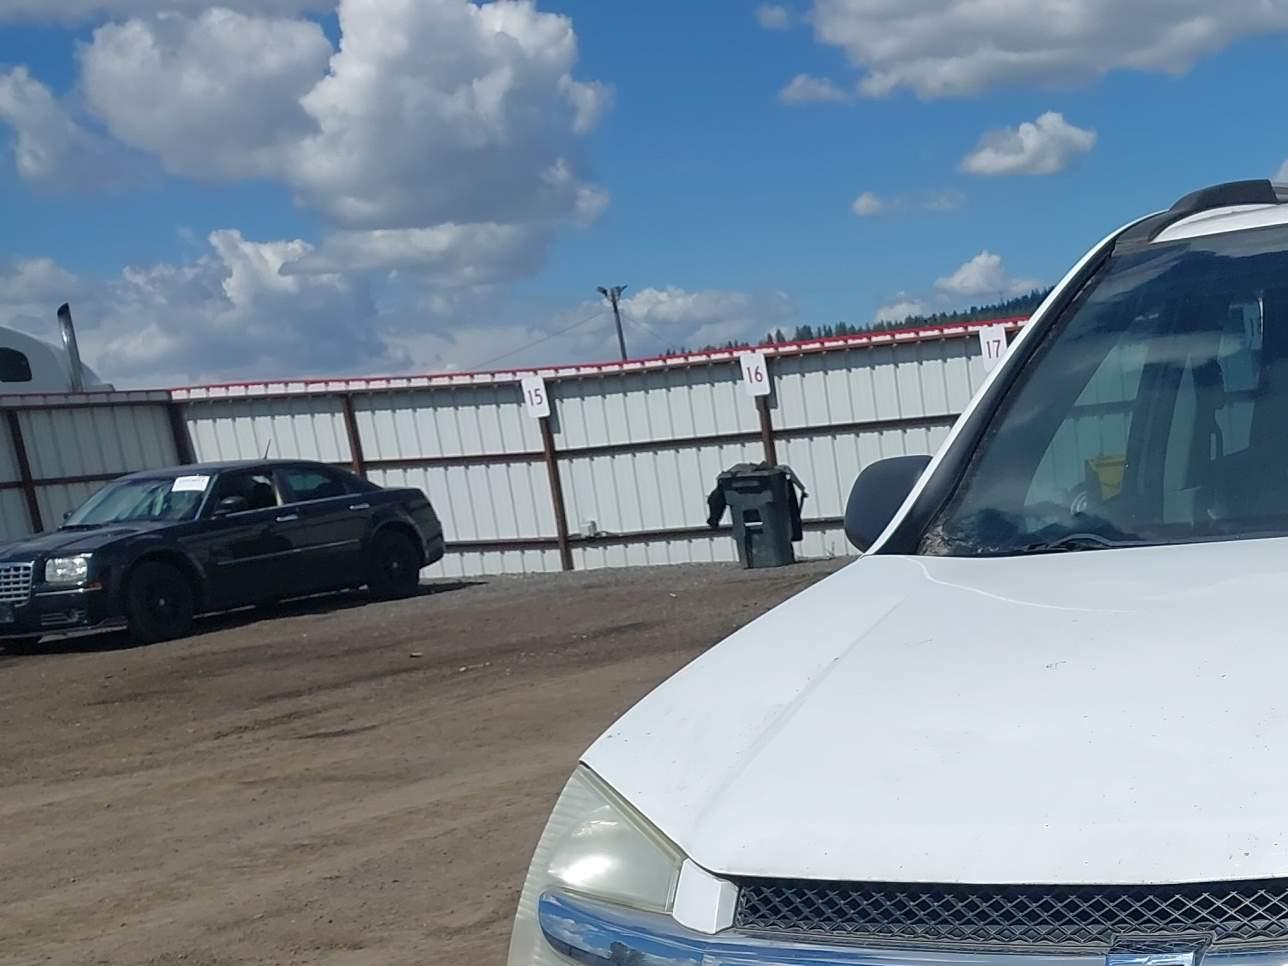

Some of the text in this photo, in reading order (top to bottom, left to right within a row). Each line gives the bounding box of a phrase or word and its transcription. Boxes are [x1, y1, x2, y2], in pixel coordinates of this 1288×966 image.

[986, 339, 1001, 359] 17
[746, 364, 764, 384] 16
[527, 388, 544, 406] 15
